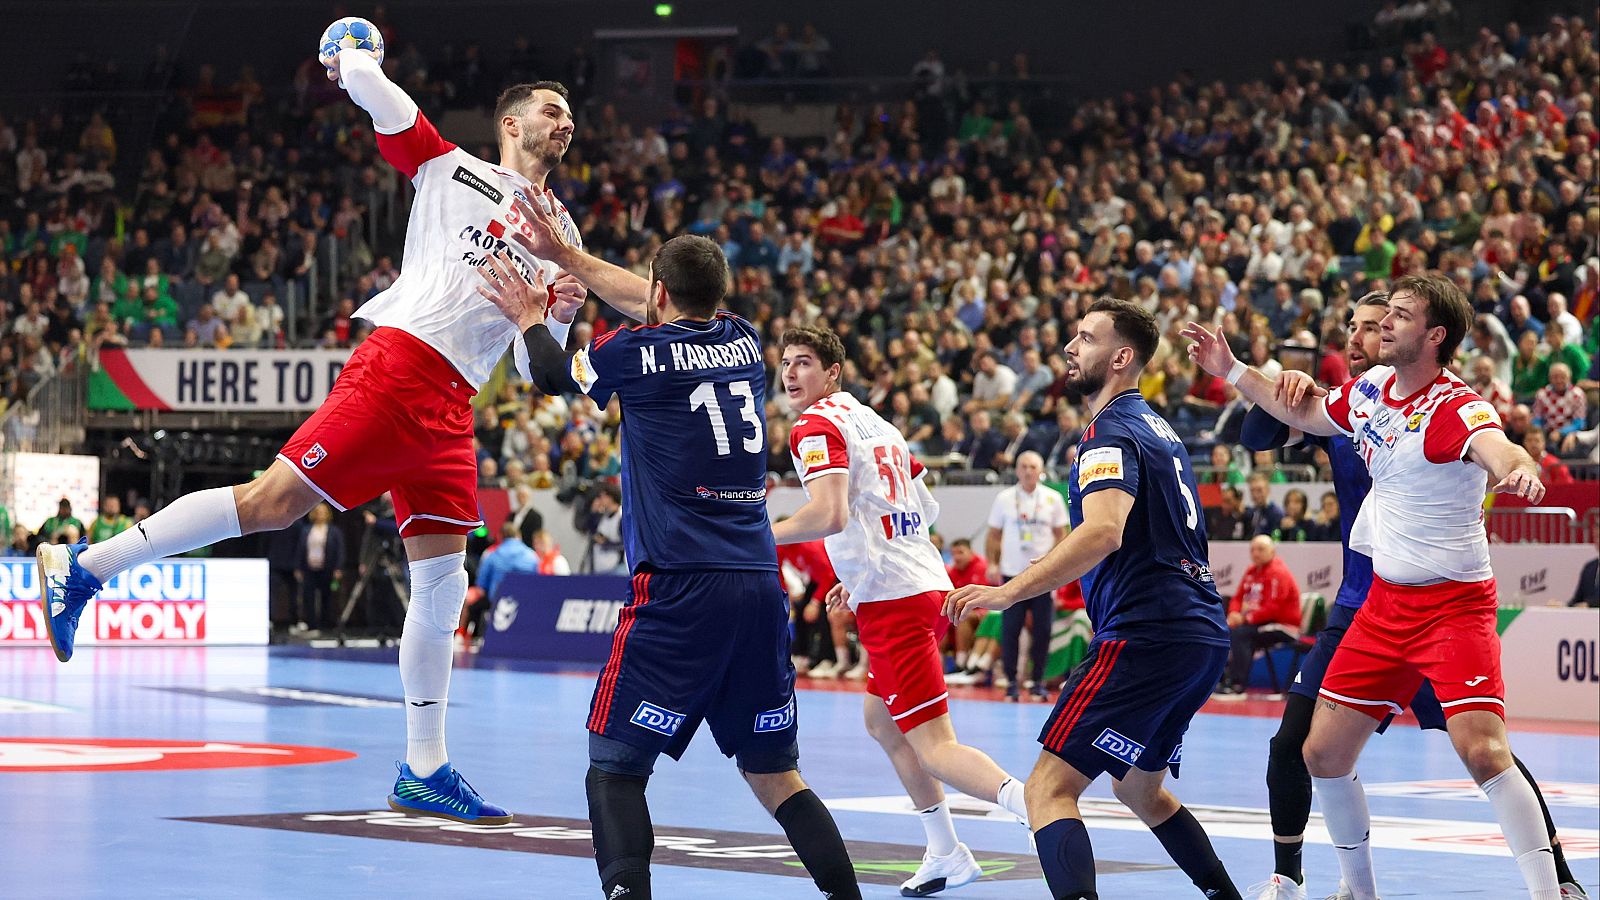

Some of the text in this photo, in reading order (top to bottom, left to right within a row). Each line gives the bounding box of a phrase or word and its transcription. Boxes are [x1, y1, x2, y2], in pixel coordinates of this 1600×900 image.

[459, 171, 499, 200] telemach
[640, 345, 666, 375] N.
[178, 360, 258, 403] HERE
[273, 360, 313, 403] TO
[689, 380, 764, 456] 13
[1173, 456, 1198, 530] 5
[98, 603, 206, 639] MOLY
[636, 706, 674, 730] FDJ
[759, 708, 791, 729] FDJ
[1099, 732, 1133, 757] FDJ
